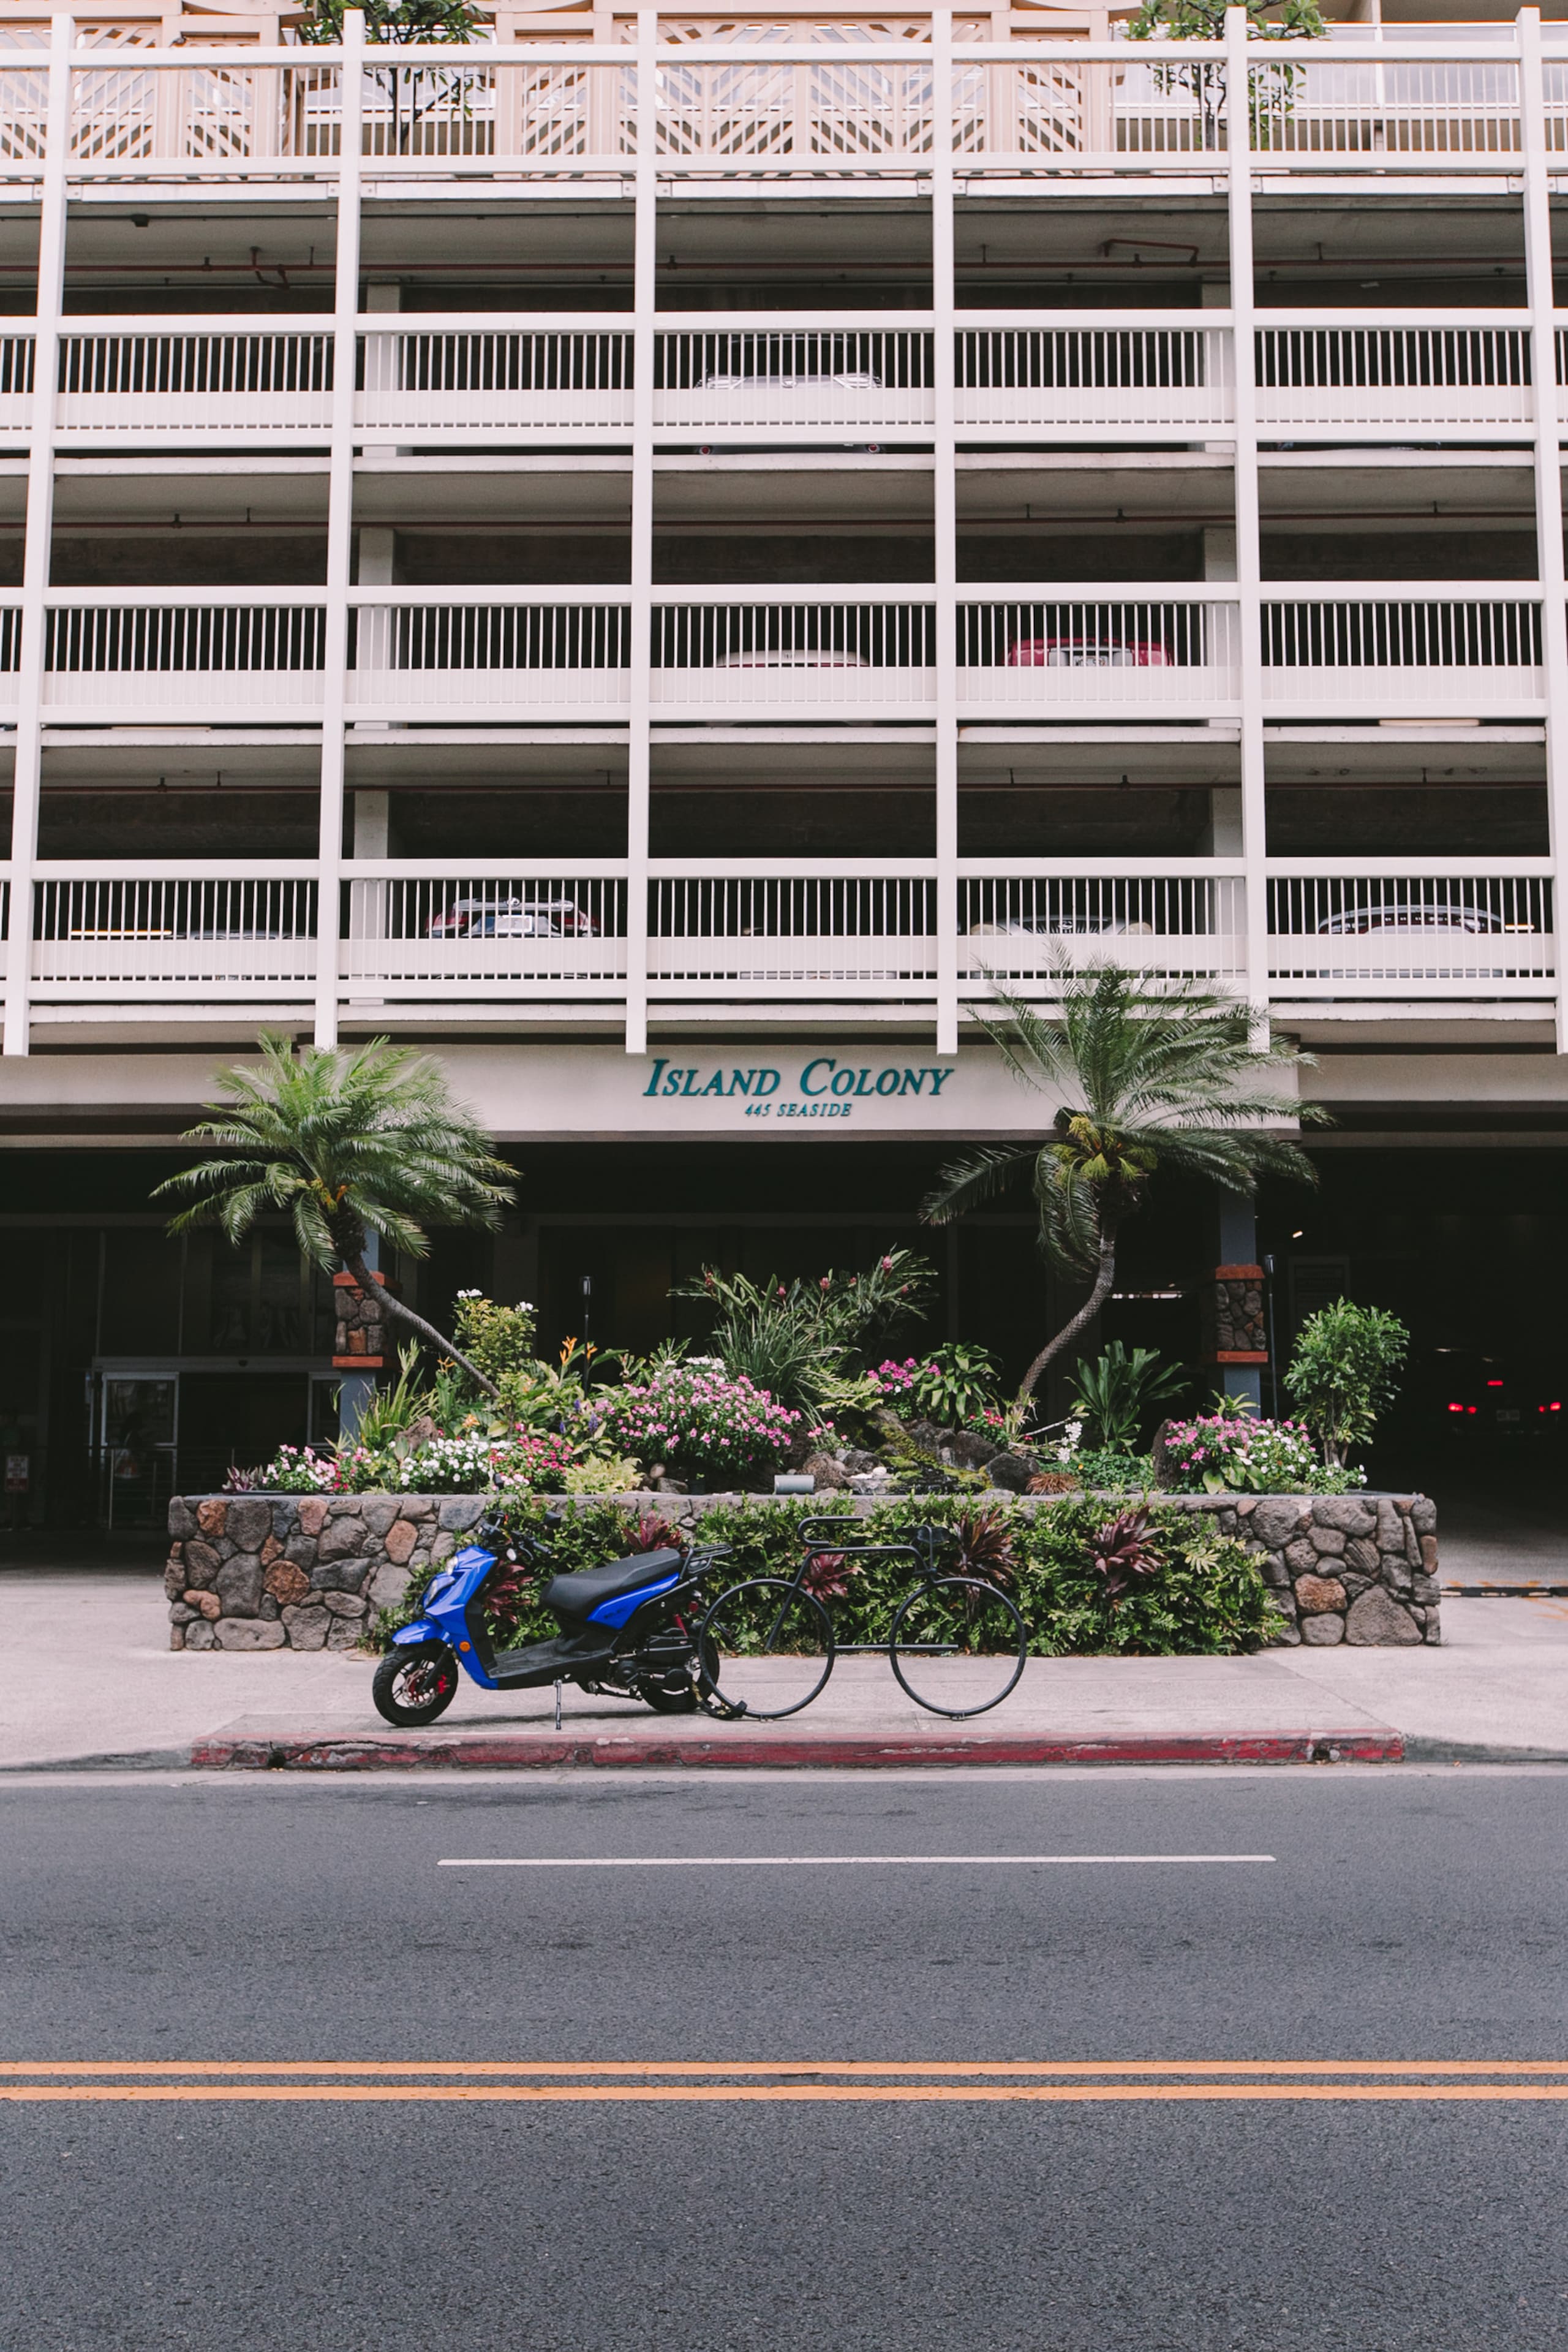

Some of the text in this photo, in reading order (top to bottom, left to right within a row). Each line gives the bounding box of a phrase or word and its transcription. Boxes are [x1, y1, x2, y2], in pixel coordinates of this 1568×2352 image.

[643, 1058, 954, 1096] ISLAND COLONY
[744, 1103, 853, 1117] 445 SEASIDE
